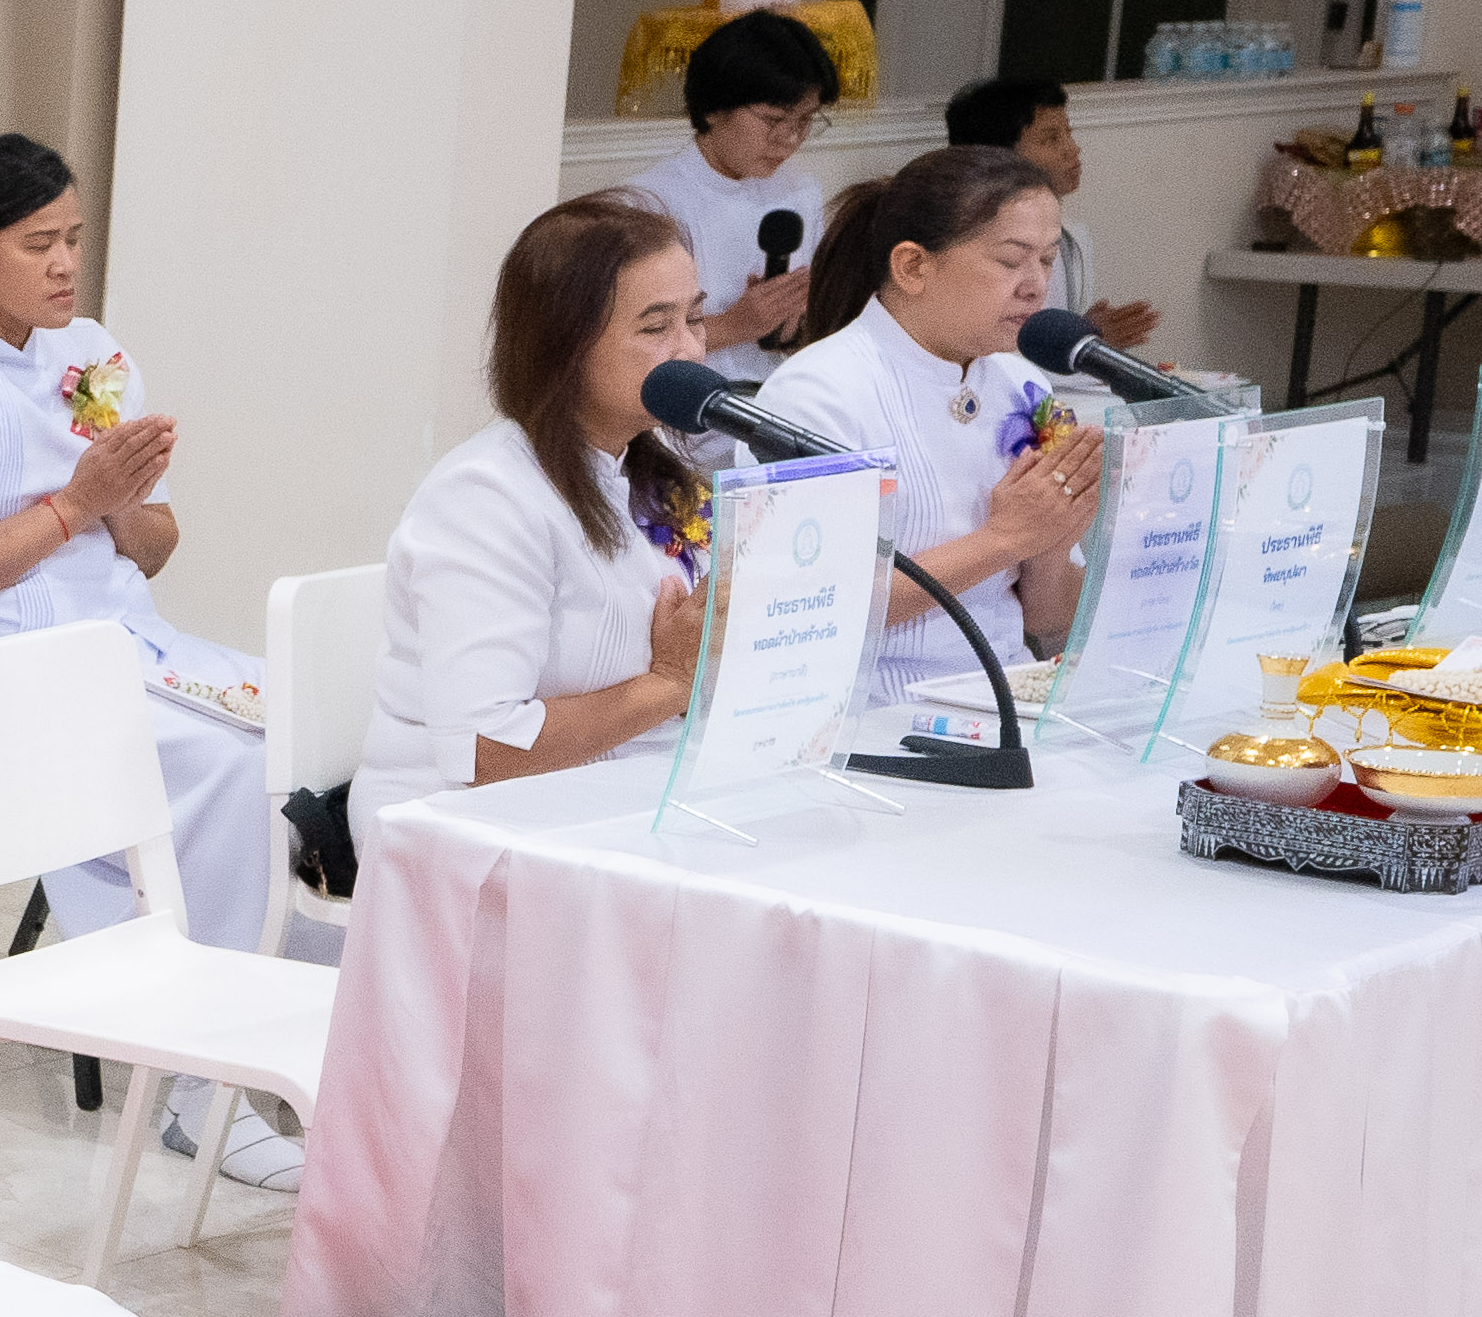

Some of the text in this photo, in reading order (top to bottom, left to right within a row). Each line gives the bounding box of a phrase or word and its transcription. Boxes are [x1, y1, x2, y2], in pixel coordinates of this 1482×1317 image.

[1261, 523, 1324, 555] ประธานพิธี
[766, 584, 836, 618] ประธานพิธี
